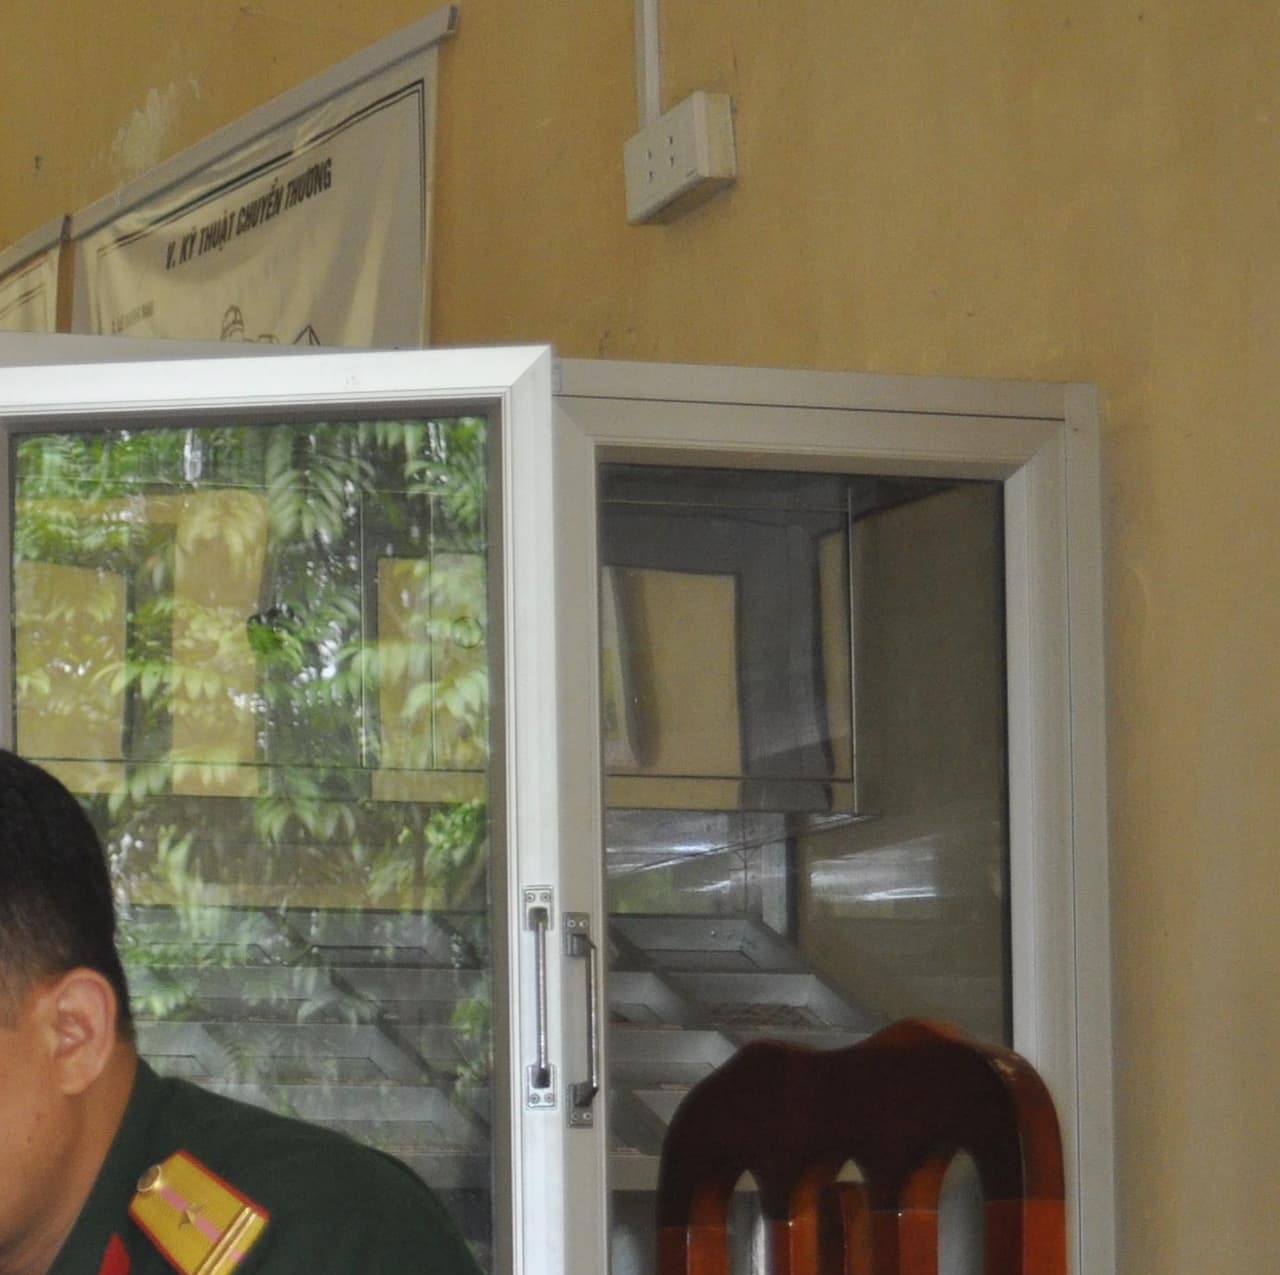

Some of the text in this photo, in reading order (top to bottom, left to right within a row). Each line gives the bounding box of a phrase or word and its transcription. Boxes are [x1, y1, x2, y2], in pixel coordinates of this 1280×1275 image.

[198, 210, 236, 251] THUẬT
[236, 177, 284, 235] CHUYỂN
[283, 158, 333, 210] THƯƠNG
